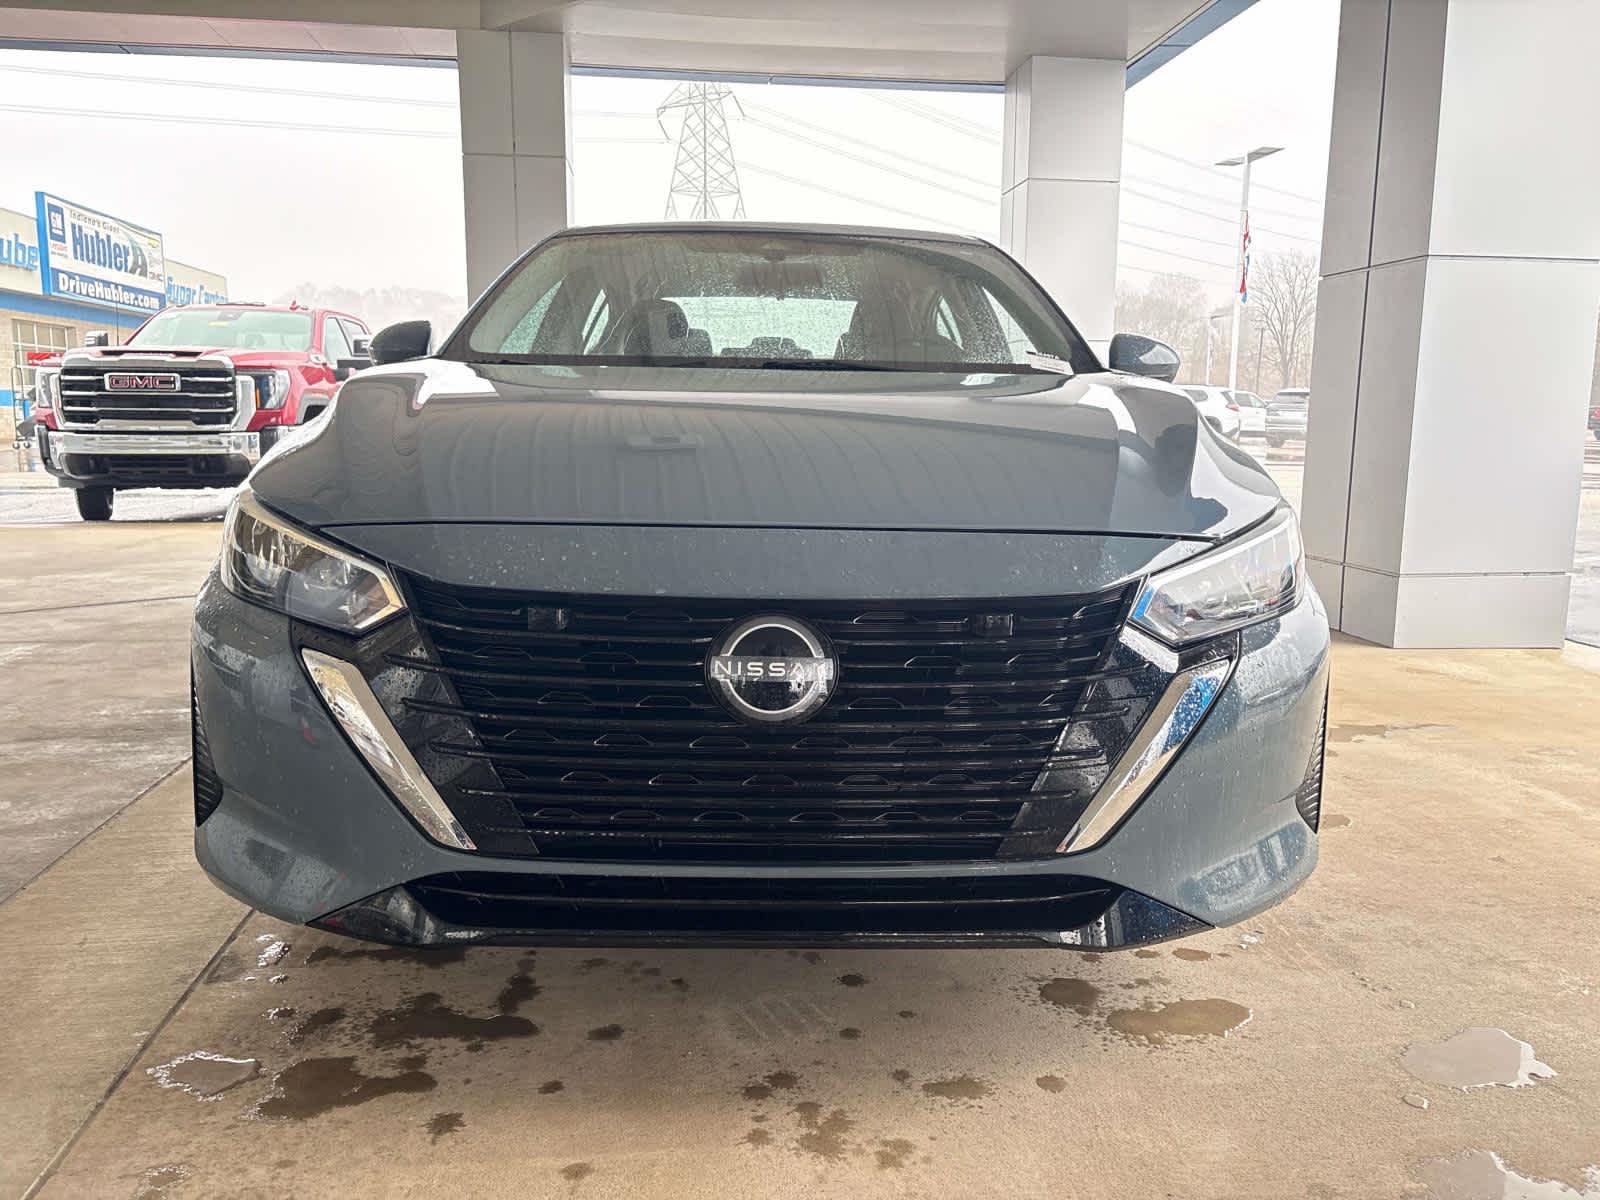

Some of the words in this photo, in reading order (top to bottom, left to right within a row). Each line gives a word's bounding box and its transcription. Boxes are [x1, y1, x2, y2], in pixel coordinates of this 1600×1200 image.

[71, 222, 130, 273] Hubler
[58, 272, 160, 310] DriveHubler.com
[109, 374, 175, 389] GMC
